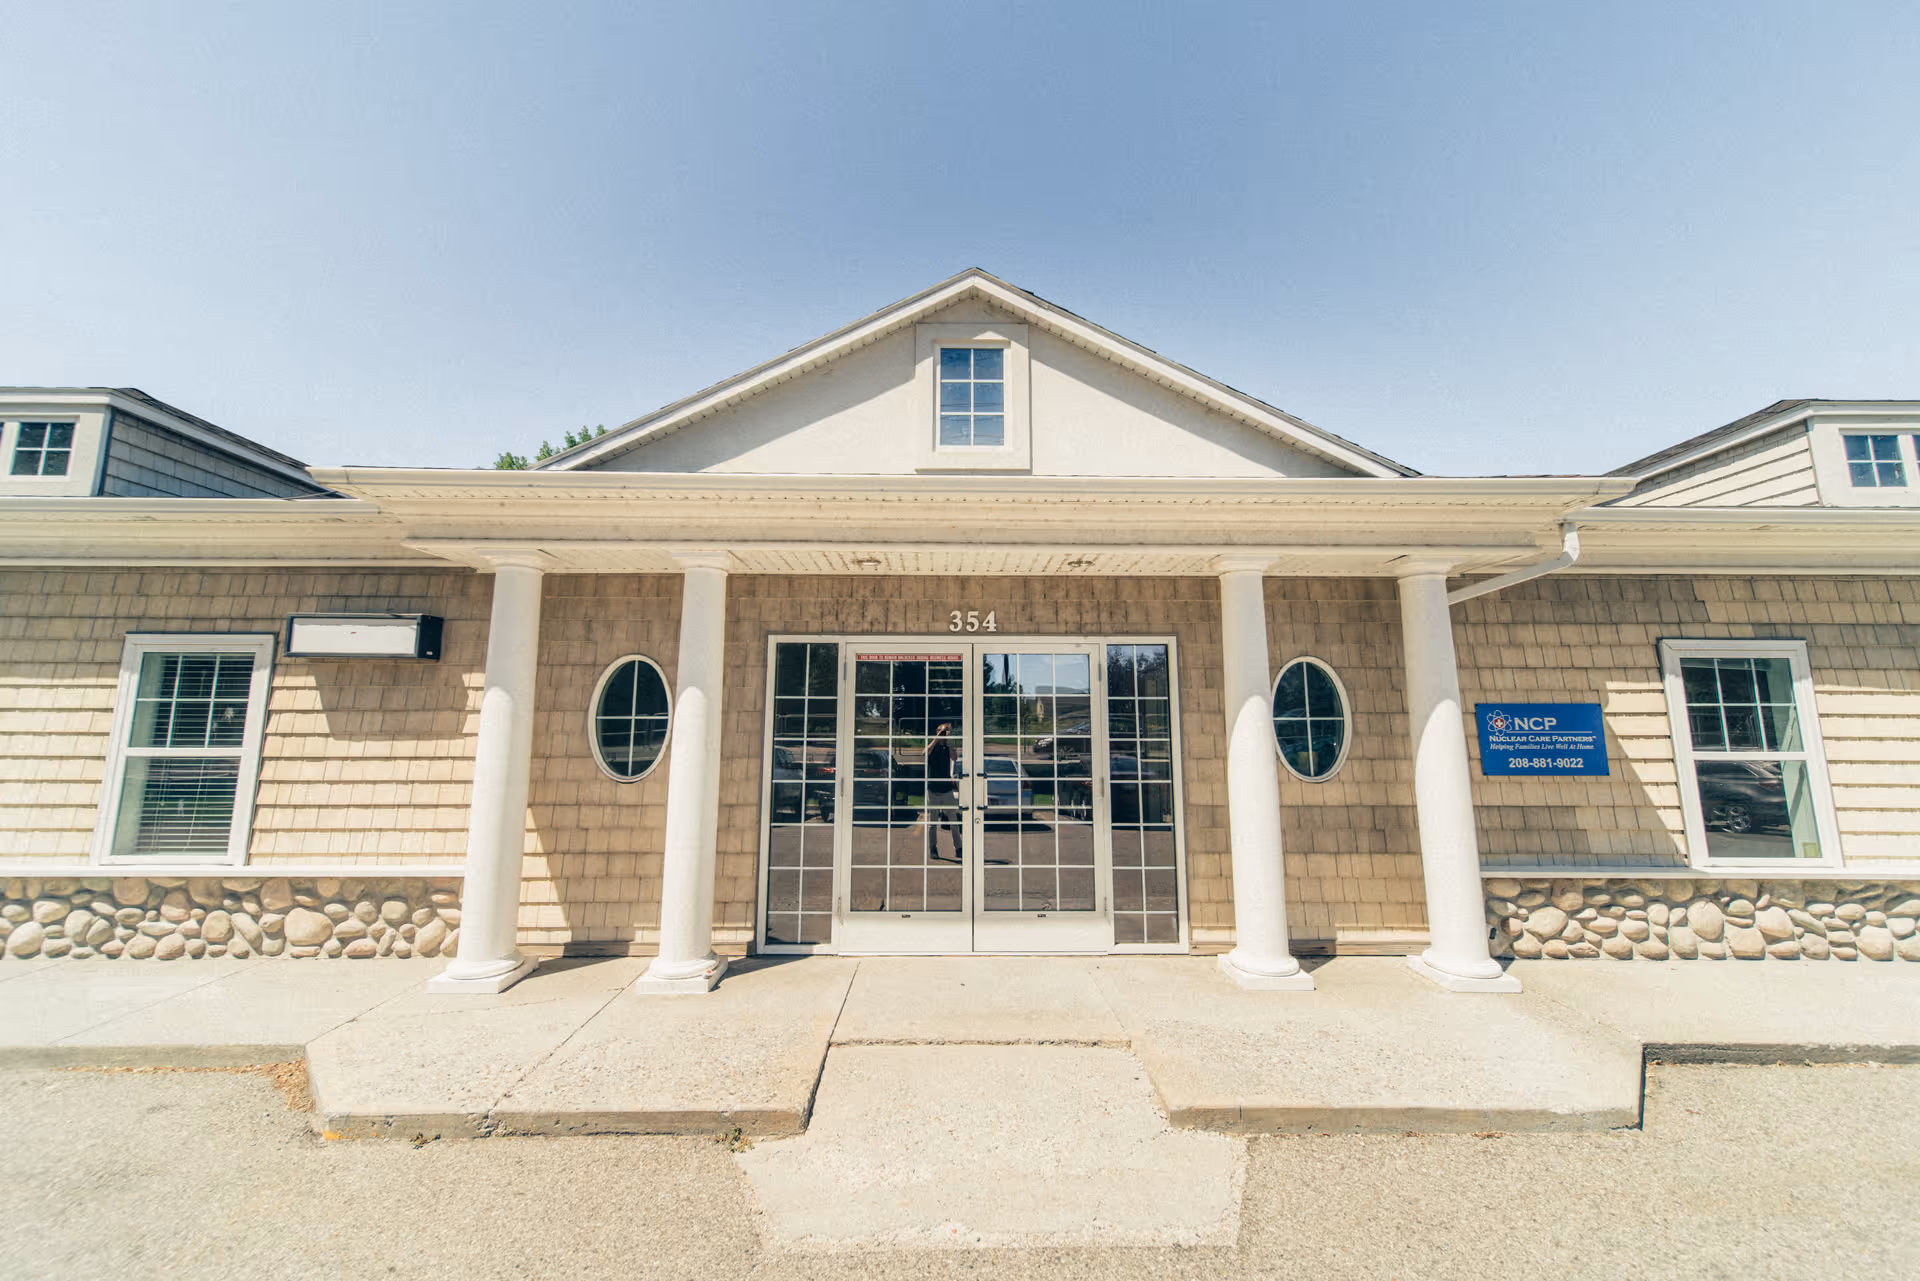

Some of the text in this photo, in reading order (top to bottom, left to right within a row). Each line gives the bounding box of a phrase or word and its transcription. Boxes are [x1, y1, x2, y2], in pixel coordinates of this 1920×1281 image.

[949, 610, 997, 632] 354
[1513, 717, 1557, 731] NCP
[1490, 743, 1514, 751] Helping
[1508, 757, 1584, 768] 208-881-9022
